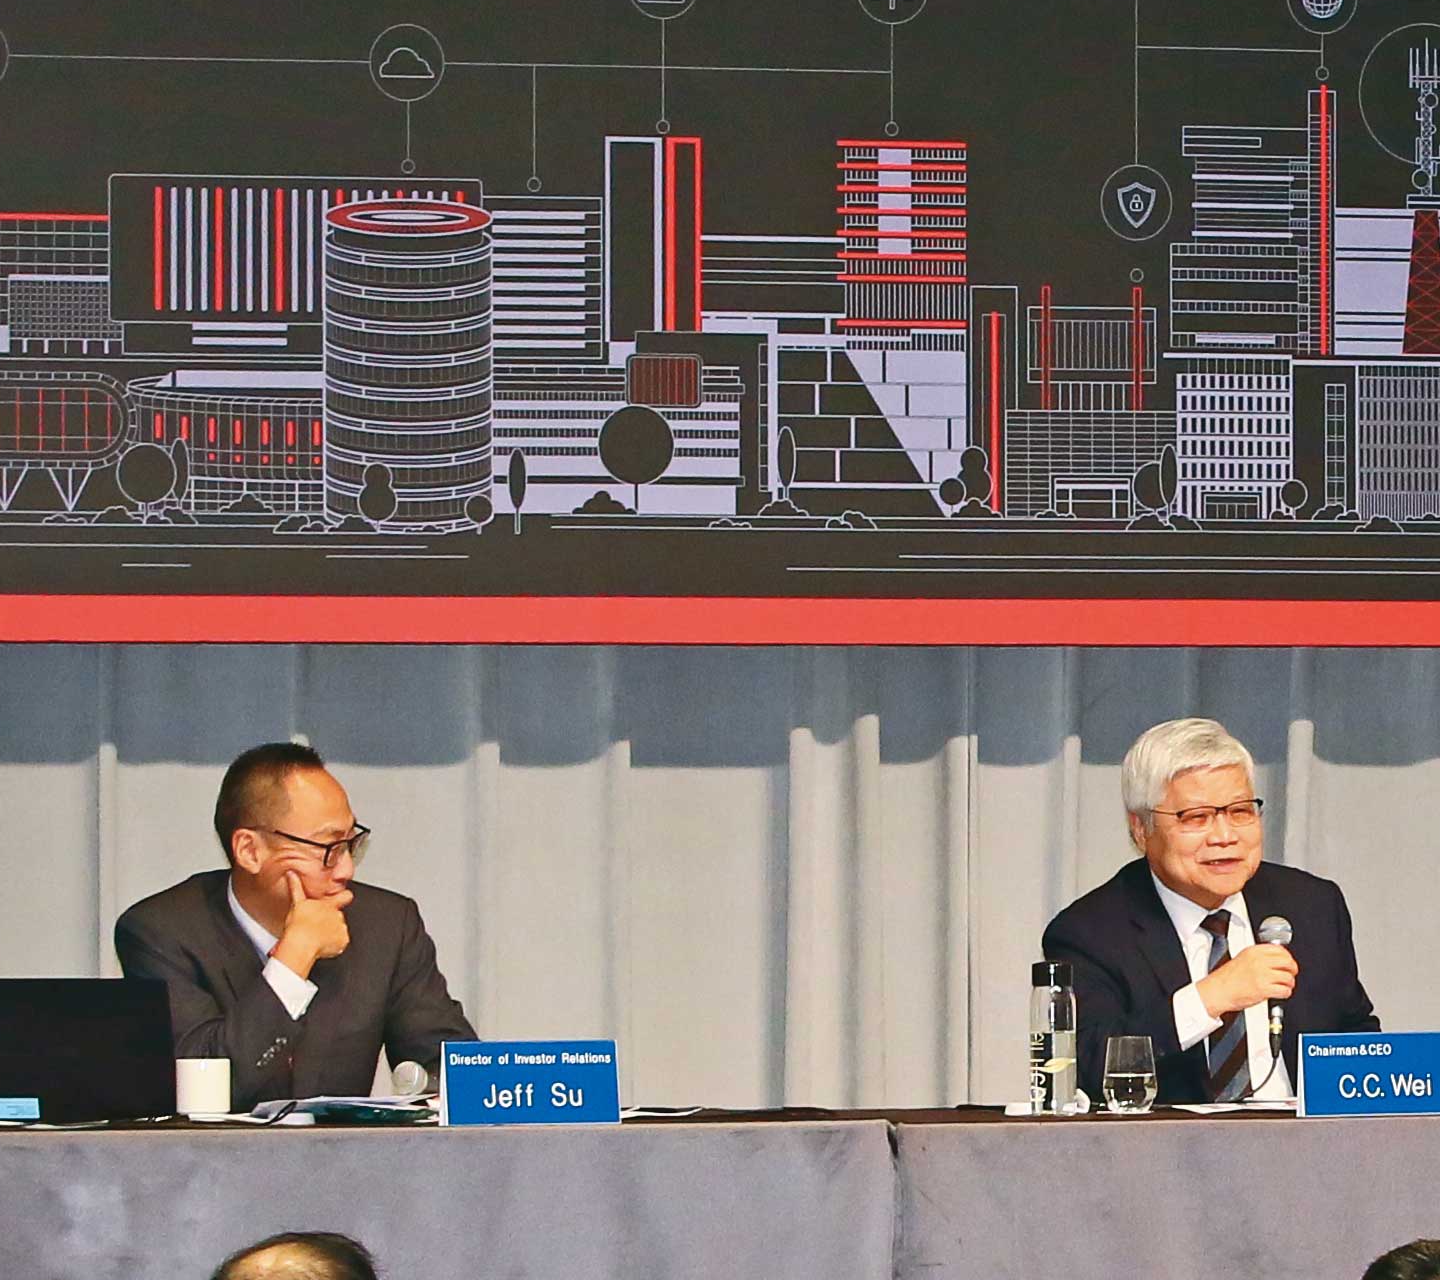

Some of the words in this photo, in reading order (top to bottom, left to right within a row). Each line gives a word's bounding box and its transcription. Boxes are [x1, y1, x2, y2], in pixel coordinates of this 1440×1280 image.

[449, 1054, 492, 1066] Director
[498, 1054, 509, 1065] of
[514, 1053, 557, 1065] Investor
[561, 1052, 611, 1064] Relations
[483, 1083, 534, 1108] Jeff
[551, 1082, 583, 1107] Su
[1339, 1073, 1385, 1099] C.C.
[1390, 1073, 1432, 1097] Wei
